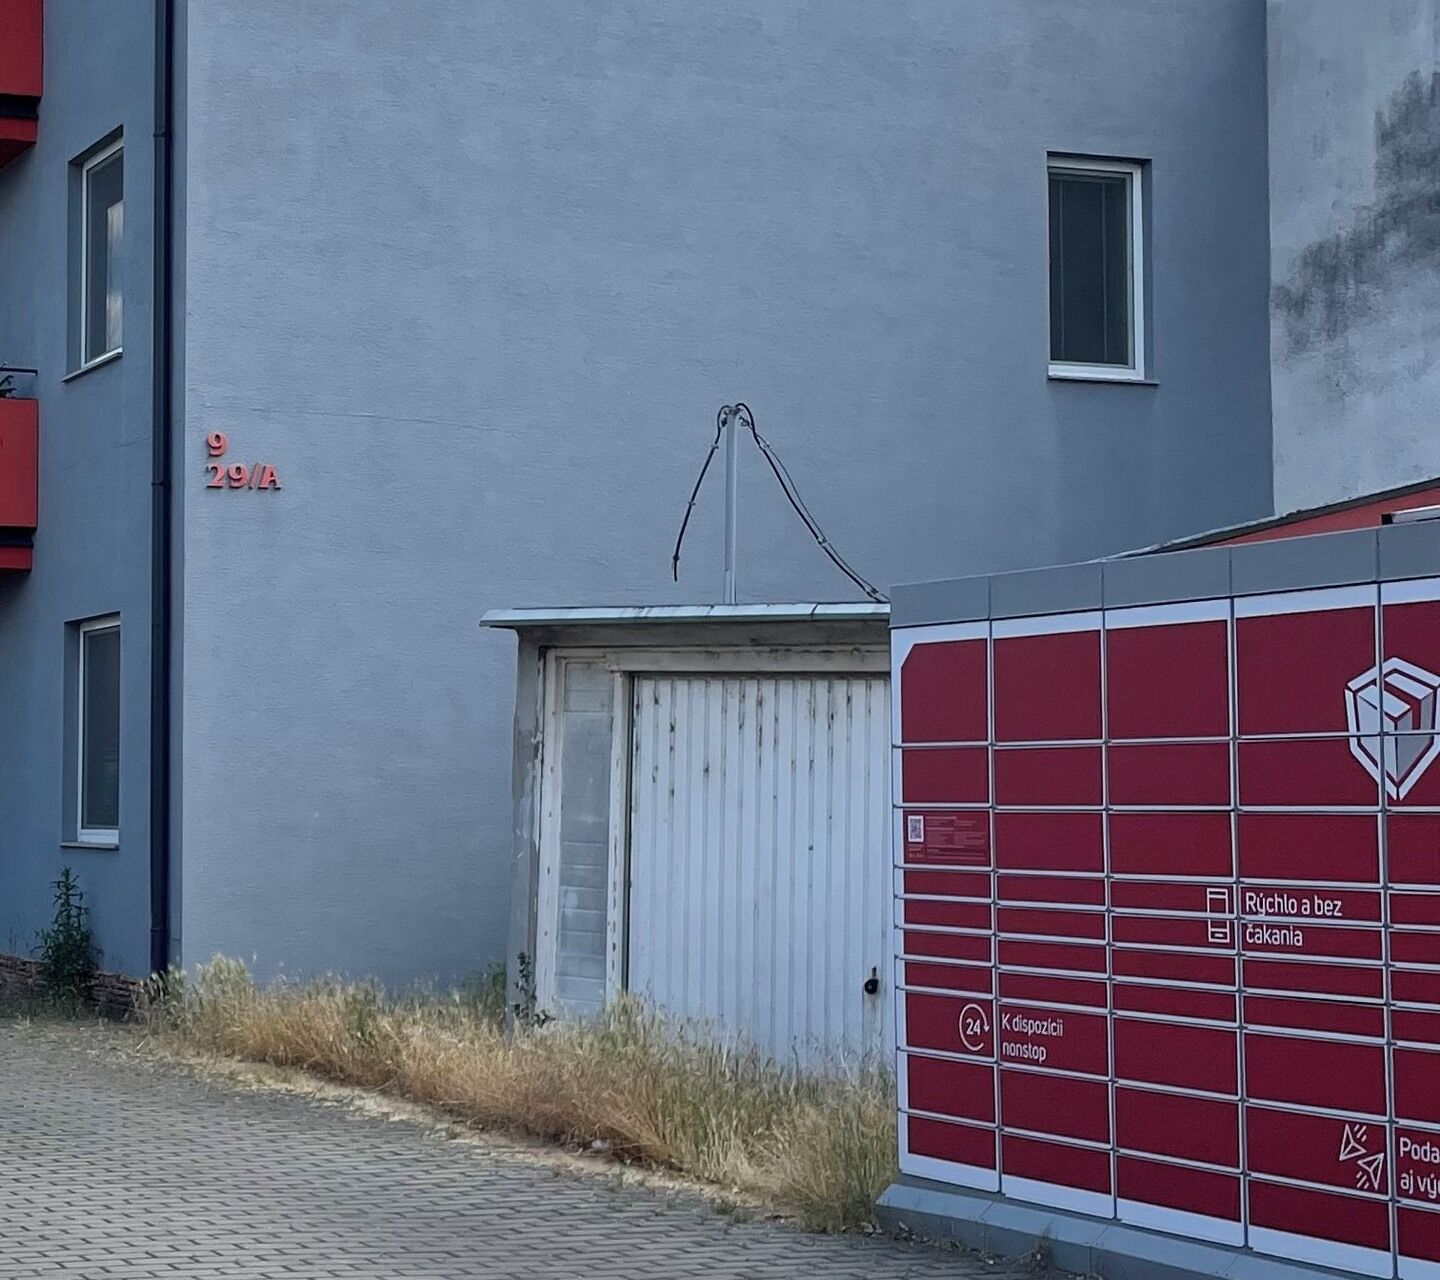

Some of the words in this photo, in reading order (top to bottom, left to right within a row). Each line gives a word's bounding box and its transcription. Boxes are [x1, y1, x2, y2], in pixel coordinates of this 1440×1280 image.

[206, 431, 229, 456] 9
[206, 463, 282, 490] 29/A
[1245, 892, 1297, 916] Rýchlo
[1301, 898, 1311, 915] a
[1314, 895, 1344, 917] bez
[1245, 923, 1304, 947] čakania
[965, 1018, 981, 1036] 24
[1001, 1012, 1011, 1031] K
[1012, 1014, 1064, 1037] dispozícii
[1002, 1041, 1048, 1064] nonstop
[1400, 1168, 1414, 1195] aj
[1416, 1172, 1440, 1199] vý
